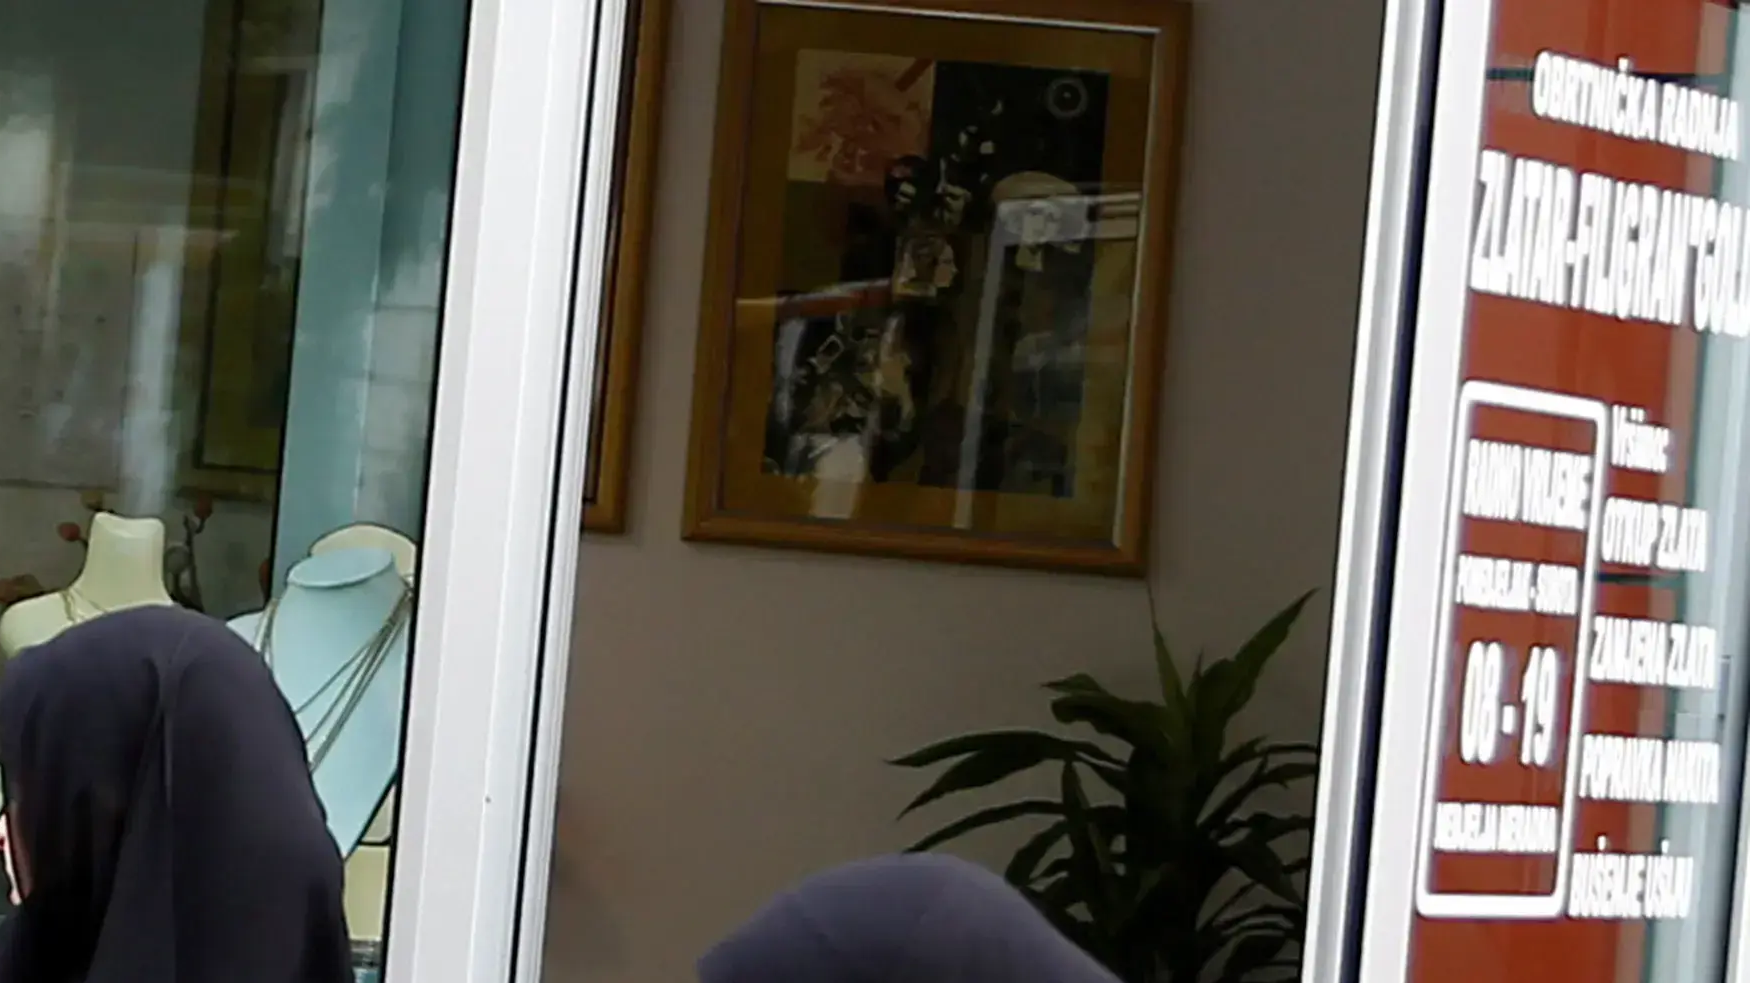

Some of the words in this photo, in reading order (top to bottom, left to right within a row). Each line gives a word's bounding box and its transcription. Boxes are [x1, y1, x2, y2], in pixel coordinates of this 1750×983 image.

[1534, 52, 1656, 140] OBRTNIČKA
[1659, 83, 1739, 161] RADNJA
[1602, 498, 1658, 565] OTKUP
[1657, 505, 1708, 572] ZLATA
[1666, 624, 1717, 688] ZLATA
